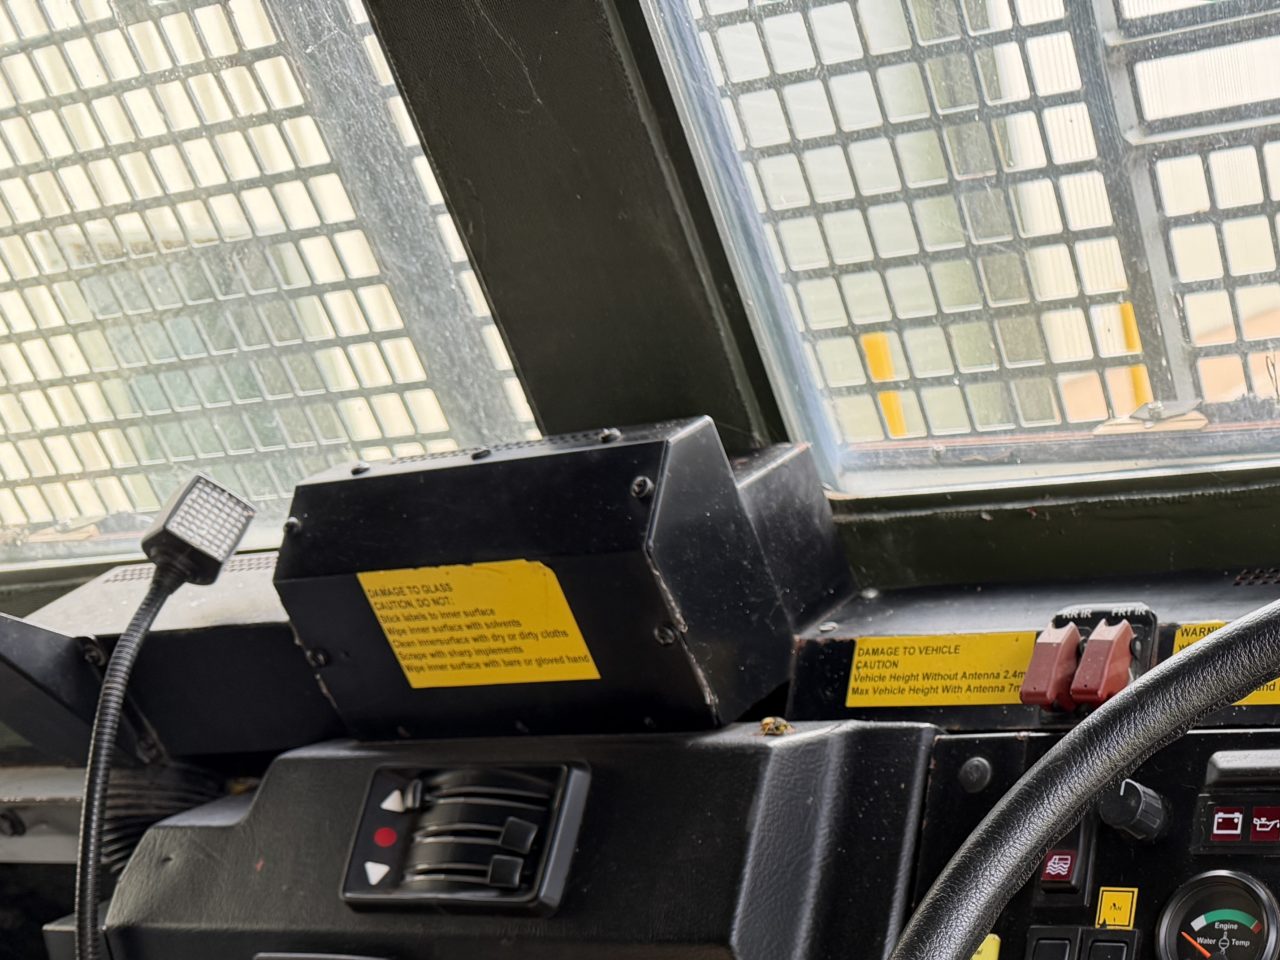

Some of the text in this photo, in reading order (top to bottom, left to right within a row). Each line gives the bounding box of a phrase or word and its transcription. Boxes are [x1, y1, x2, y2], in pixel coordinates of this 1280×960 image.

[367, 583, 453, 598] DAMAGE TO GLASS
[416, 598, 430, 608] DO
[404, 613, 428, 622] labels
[429, 612, 438, 620] to
[463, 607, 495, 617] surface
[387, 619, 522, 637] Wipe inner surface with solvents
[393, 639, 416, 648] Clean
[472, 634, 488, 642] with
[491, 633, 506, 643] dry
[519, 630, 540, 641] dirty
[541, 629, 569, 639] cloths
[399, 646, 524, 660] Scrape with sharp implements
[858, 645, 961, 657] DAMAGE TO VEHICLE
[405, 664, 425, 673] Wipe
[427, 663, 448, 671] inner
[449, 661, 481, 670] surface
[483, 659, 500, 668] with
[501, 658, 521, 667] bare
[535, 656, 565, 668] gloved
[566, 654, 590, 664] hand
[856, 660, 900, 670] CAUTION
[854, 673, 887, 683] Vehicle
[889, 672, 919, 683] Height
[922, 671, 959, 681] Without
[961, 671, 1000, 680] Antenna
[852, 686, 869, 696] Max
[872, 686, 905, 695] Vehicle
[908, 685, 938, 696] Height
[941, 685, 963, 694] With
[965, 684, 1005, 693] Antenna
[1214, 922, 1238, 931] Engine
[1197, 937, 1216, 946] Water
[1231, 938, 1250, 948] Temp
